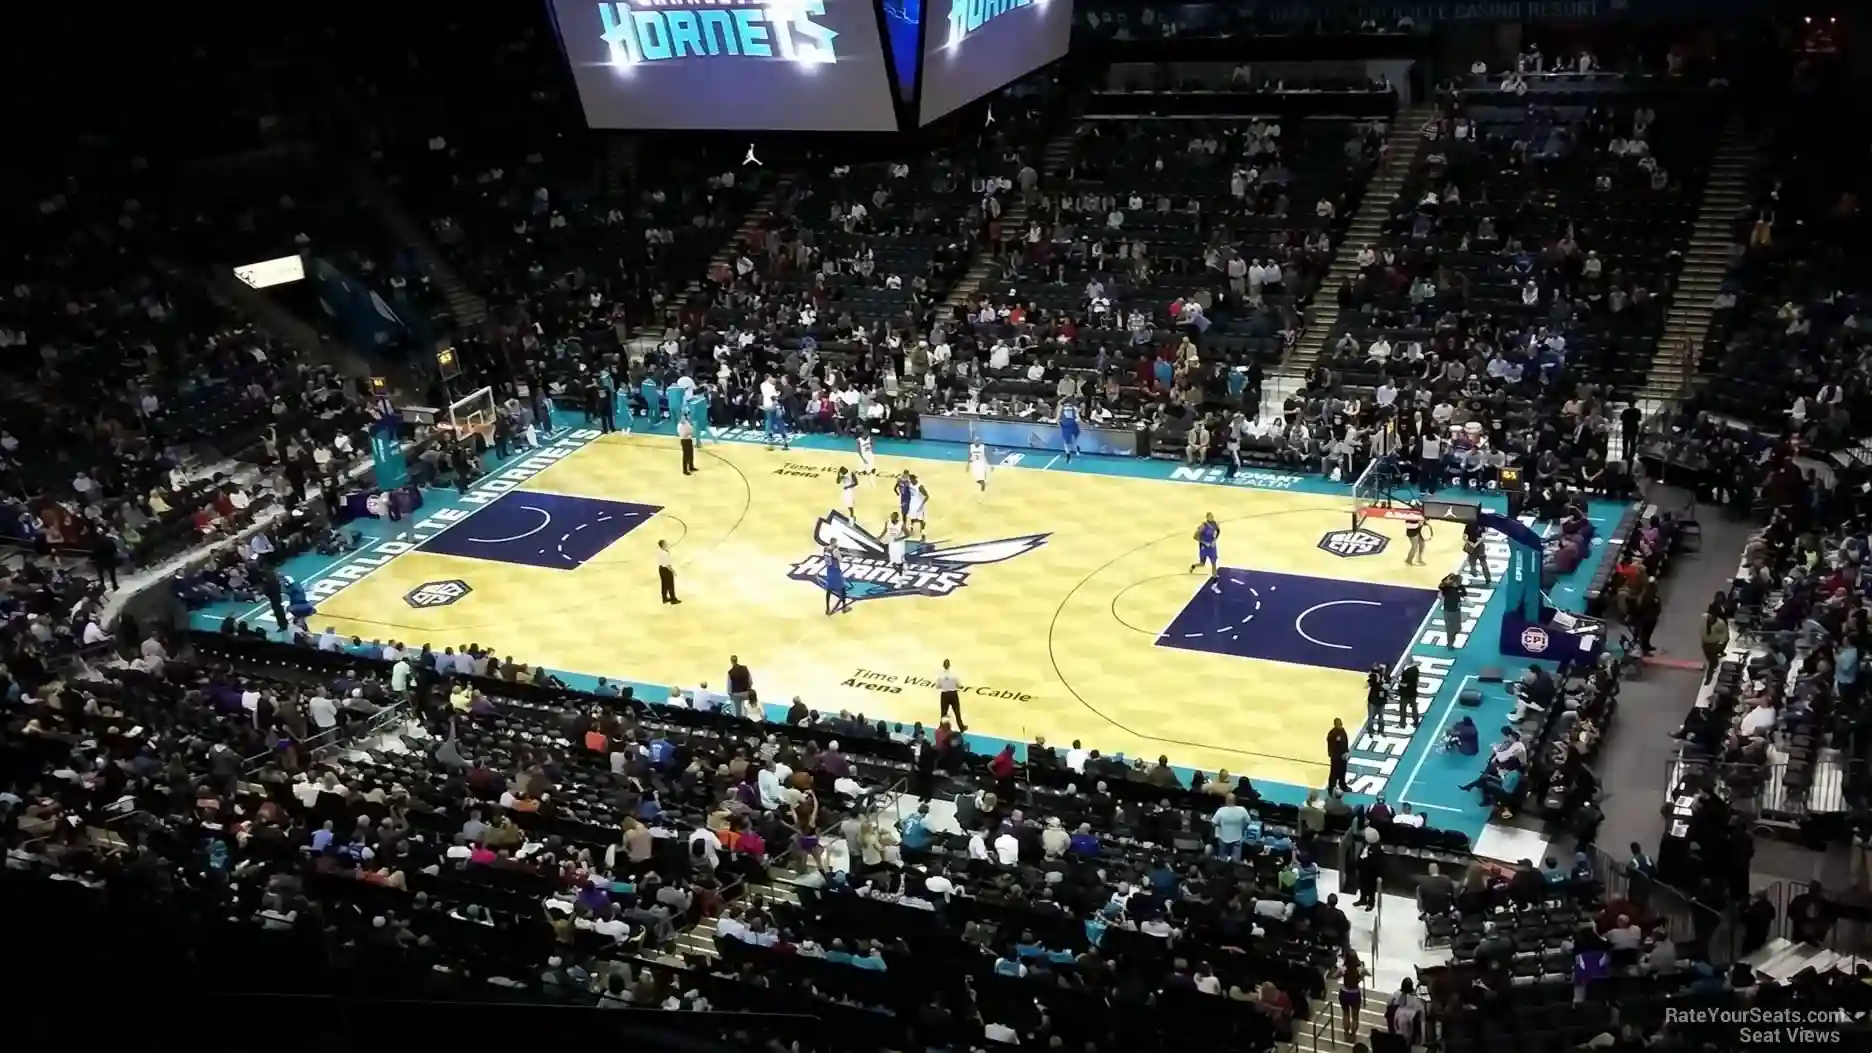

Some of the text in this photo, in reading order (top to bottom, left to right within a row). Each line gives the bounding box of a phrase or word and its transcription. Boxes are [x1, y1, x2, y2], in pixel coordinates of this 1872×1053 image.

[600, 0, 839, 63] HORNETS
[255, 428, 603, 621] ARLOTE HORNETS
[841, 678, 902, 695] Arena
[854, 668, 1032, 702] Time Warer Cable
